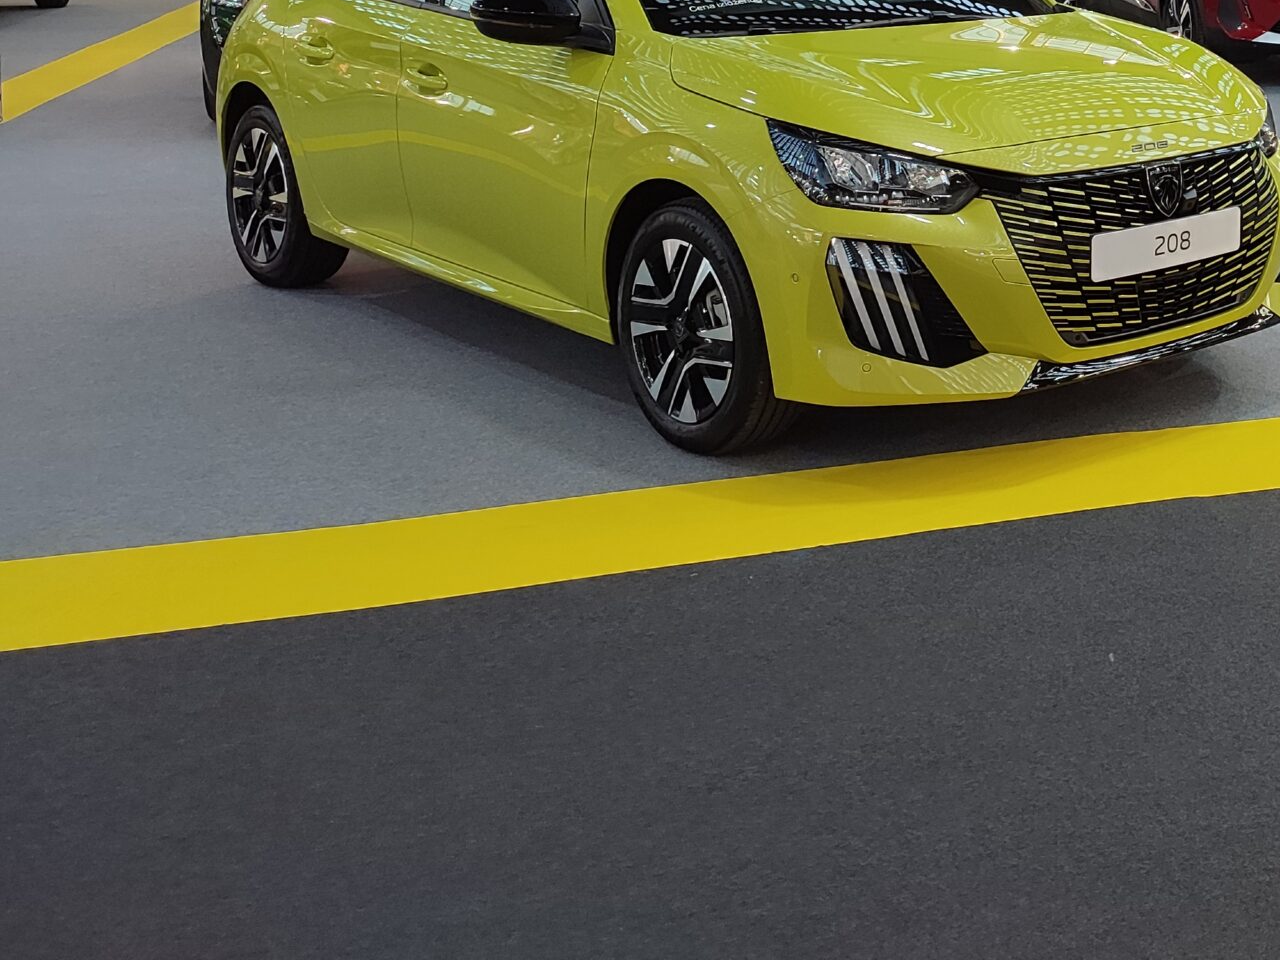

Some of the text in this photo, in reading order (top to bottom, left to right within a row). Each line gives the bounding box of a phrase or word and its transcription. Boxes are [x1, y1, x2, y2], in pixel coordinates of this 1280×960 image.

[689, 3, 716, 12] Cena
[1131, 140, 1169, 153] 208
[1155, 230, 1191, 257] 208
